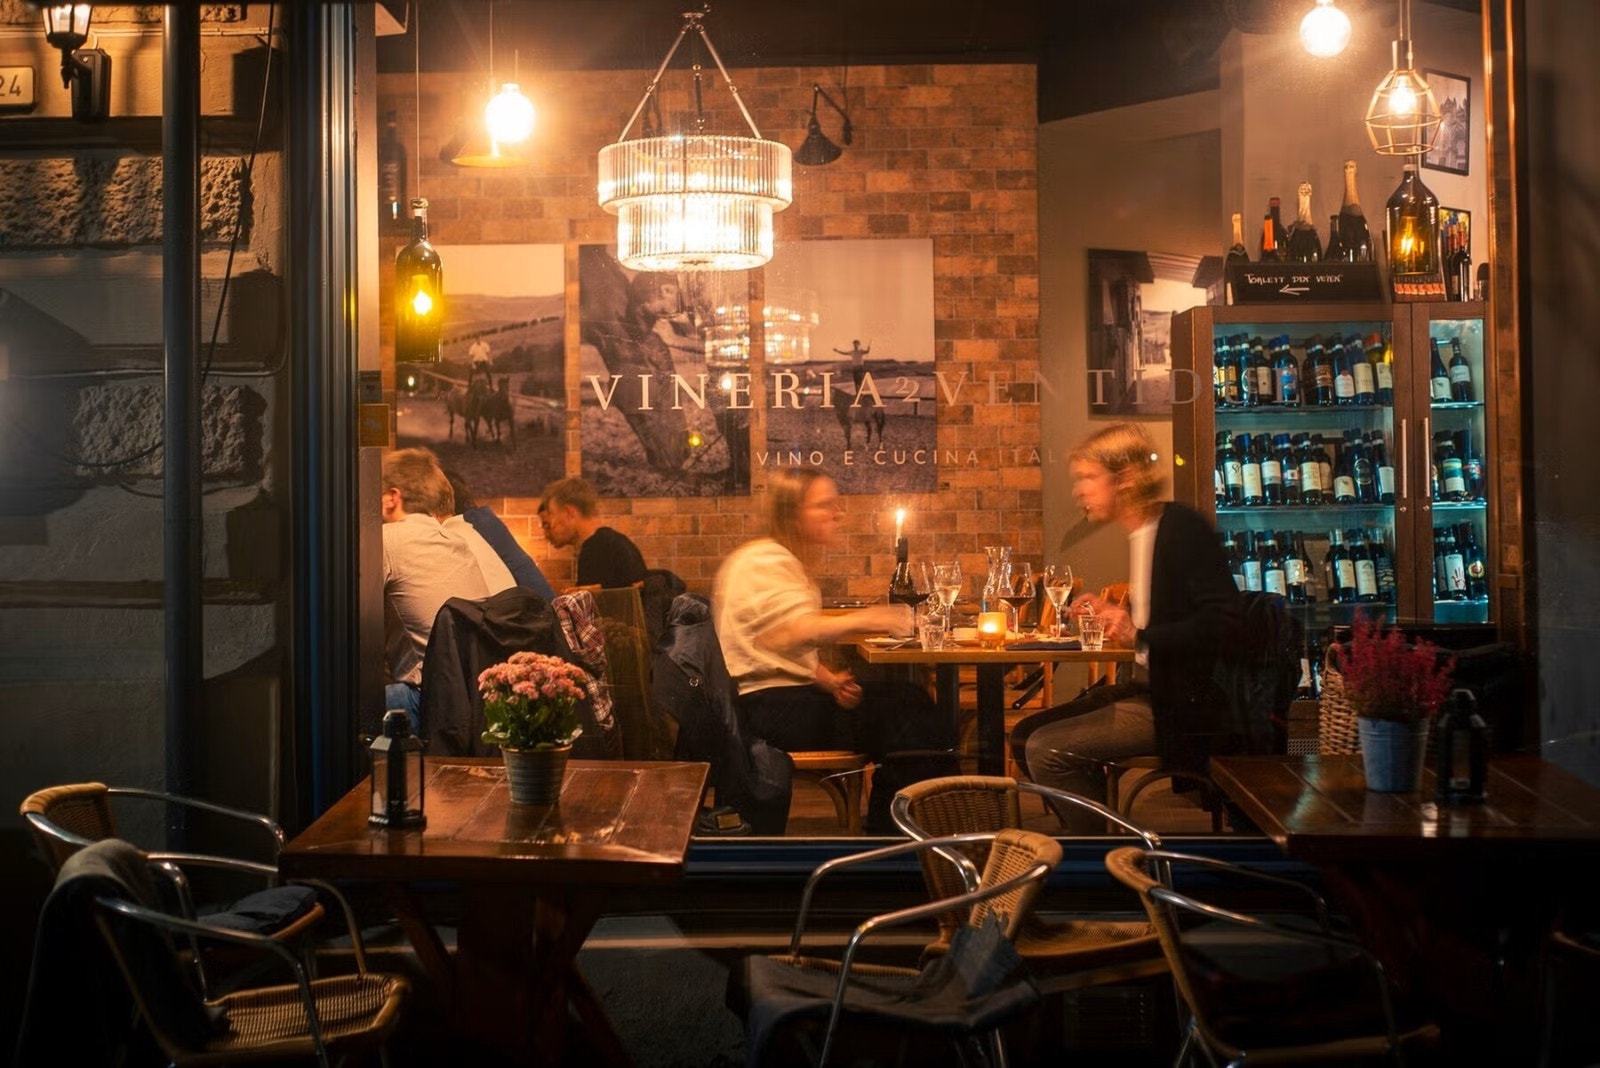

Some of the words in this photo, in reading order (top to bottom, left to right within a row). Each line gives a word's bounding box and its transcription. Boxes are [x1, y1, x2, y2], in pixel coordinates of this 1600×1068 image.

[586, 371, 887, 411] VINERIA
[757, 451, 824, 466] VINO
[844, 450, 855, 465] E
[874, 449, 979, 465] CUCINA
